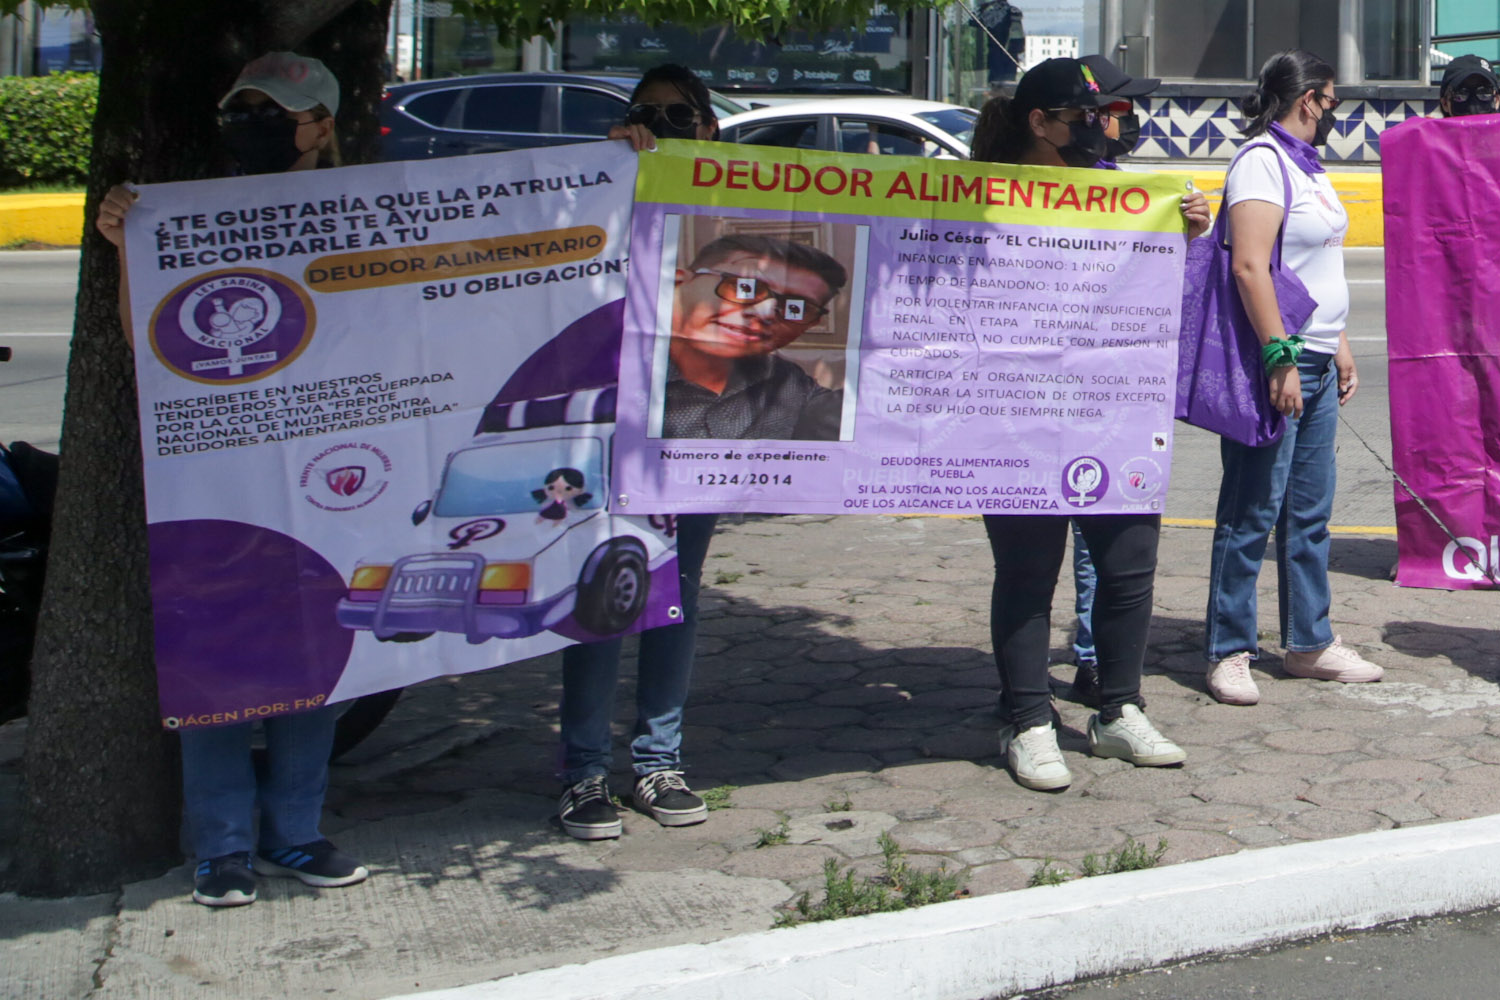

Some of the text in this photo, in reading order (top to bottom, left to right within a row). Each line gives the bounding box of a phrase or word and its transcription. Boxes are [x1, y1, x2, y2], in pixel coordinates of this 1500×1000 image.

[692, 156, 1150, 216] DEUDOR ALIMENTARIO
[215, 171, 613, 226] GUSTARÍA QUE LA PATRULLA
[157, 202, 500, 251] FEMINISTAS TE AYUDE A
[899, 228, 940, 244] Julio
[944, 230, 991, 245] César
[158, 226, 429, 270] RECORDARLE A TU
[308, 234, 602, 284] DEUDOR ALIMENTARIO
[898, 253, 1116, 273] INFANCIAS EN ABANDONO: NIÑO
[422, 282, 457, 301] SU
[896, 274, 1108, 294] TIEMPO DE ABANDONO: 10 AÑOS
[895, 296, 1173, 318] POR VIOLENTAR INFANCIA CON INSUFICIENCIA
[894, 313, 1171, 334] RENAL EN ETAPA DESDE EL
[199, 327, 268, 348] NACIONAL
[892, 331, 1168, 349] NACIMIENTO NO CUMPLE CON NI
[889, 368, 1167, 386] PARTICIPA EN ORGANIZACIÓN SOCIAL PARA
[154, 372, 383, 411] INSCRÍBETE EN NUESTROS
[154, 372, 454, 422] TENDEDEROS Y SERÁS ACUERPADA
[888, 386, 1167, 403] MEJORAR LA DE OTROS EXCEPTO
[156, 421, 194, 434] POR
[200, 418, 222, 429] LA
[227, 405, 324, 426] COLECTIVA
[887, 403, 902, 414] LA
[906, 404, 922, 414] DE
[925, 404, 942, 415] SU
[946, 405, 975, 416] HIJO
[979, 405, 1007, 417] QUE
[1010, 406, 1065, 418] SIEMPRE
[157, 397, 431, 445] NACIONAL DE MUJERES CONTRA
[158, 435, 259, 456] DEUDORES
[264, 415, 387, 443] ALIMENTARIOS
[660, 450, 830, 463] Número de expediente:
[880, 456, 1030, 468] DEUDORES ALIMENTARIOS
[697, 473, 793, 486] 1224/2014
[930, 469, 975, 479] PUEBLA
[857, 484, 1048, 496] SI LA JUSTICIA NO LOS ALCANZA
[843, 496, 1060, 510] QUE LOS ALCANCE LA VERGÜENZA
[244, 693, 326, 718] POR: FKP
